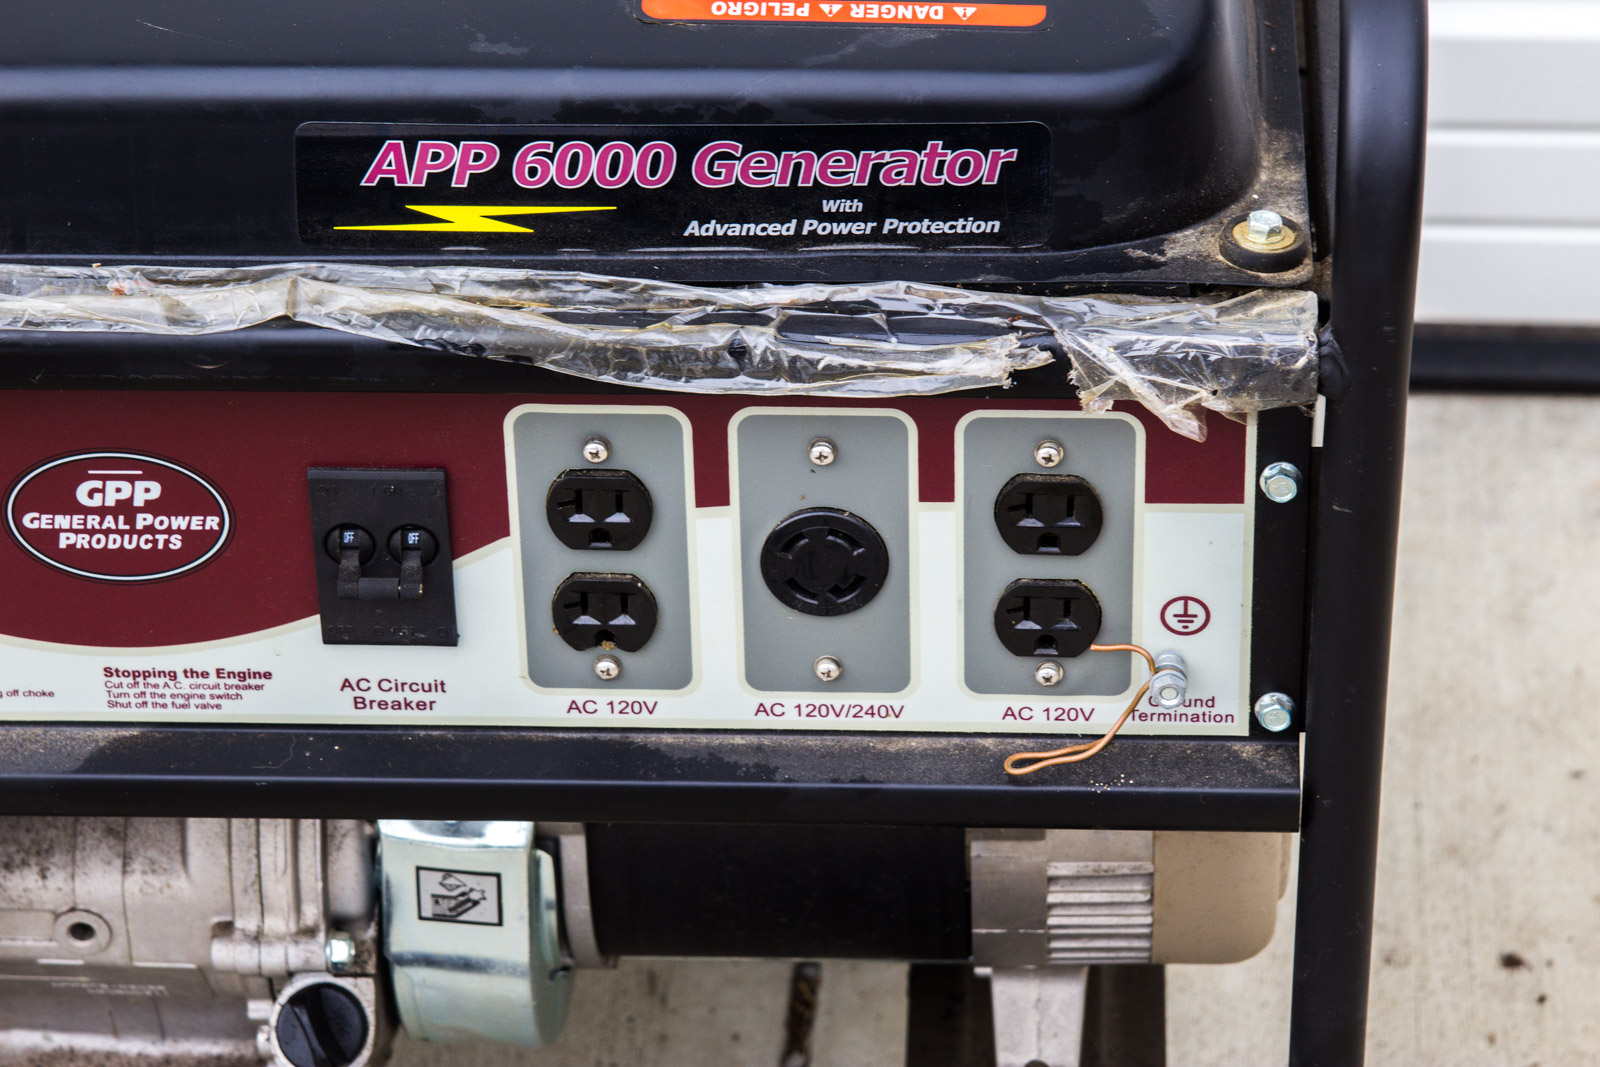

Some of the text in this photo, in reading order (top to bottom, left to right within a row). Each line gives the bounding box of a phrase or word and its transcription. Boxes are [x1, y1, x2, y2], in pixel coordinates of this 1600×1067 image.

[710, 1, 944, 20] DANGER PELIGRO
[360, 140, 1019, 189] APP 6000 Generator
[821, 199, 863, 213] With
[683, 218, 1000, 237] Advanced Power Protection
[75, 479, 162, 507] GPP
[343, 532, 354, 543] OFF
[407, 533, 419, 544] OFF
[103, 666, 273, 682] Stopping the Engine
[104, 680, 265, 692] Cut off the A.C. circuit breaker
[340, 678, 447, 693] AC Circuit
[6, 689, 20, 698] off
[22, 689, 56, 698] choke
[106, 689, 243, 703] Turn off the engine switch
[106, 699, 222, 711] Shut off the fuel valve
[353, 696, 437, 711] Breaker
[567, 699, 658, 716] AC 120V
[754, 702, 904, 719] AC 120V/240V
[1002, 706, 1095, 722] AC 120V
[1131, 709, 1235, 724] Termination
